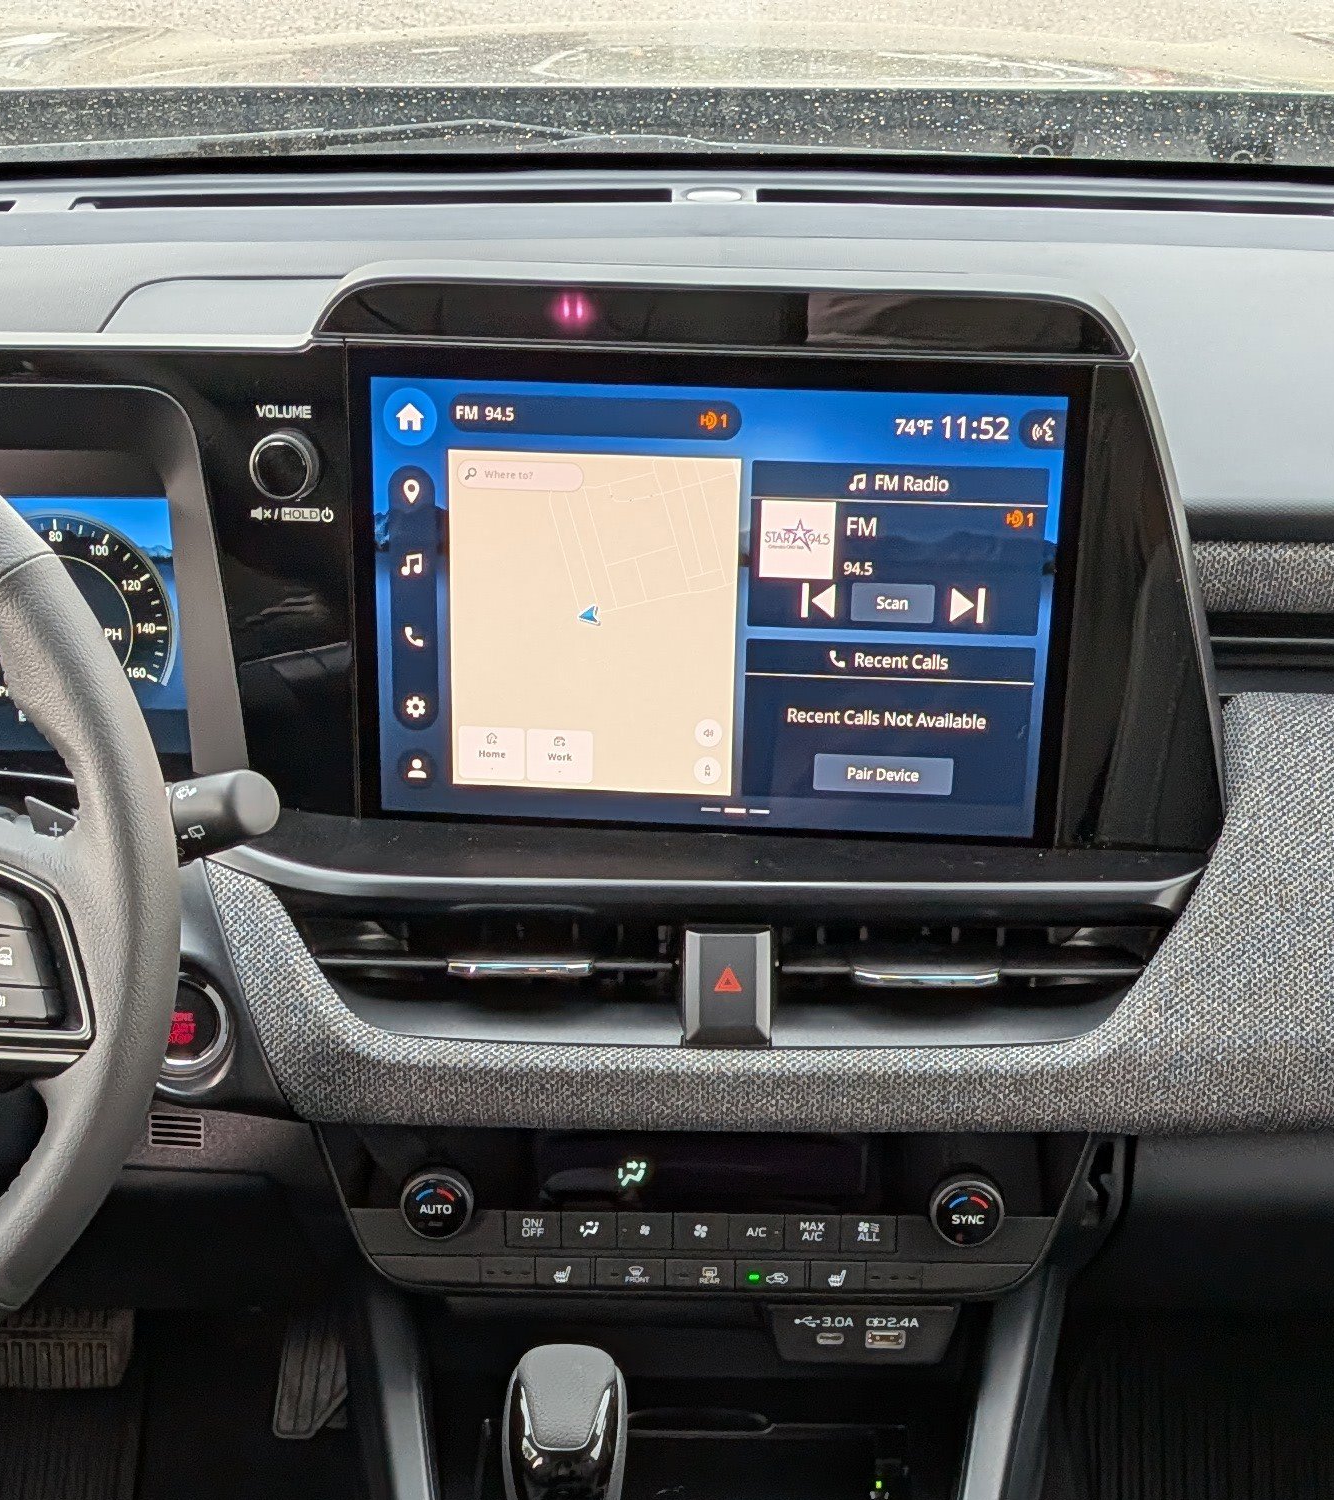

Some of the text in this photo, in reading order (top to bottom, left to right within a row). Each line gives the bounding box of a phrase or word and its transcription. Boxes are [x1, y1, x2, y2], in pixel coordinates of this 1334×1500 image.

[255, 404, 312, 419] VOLUME
[455, 406, 515, 421] FM 94.5
[895, 415, 1010, 441] 74°F 11:52
[484, 469, 534, 481] Where to?
[874, 474, 950, 492] FM Radio
[283, 509, 319, 520] HOLD
[846, 516, 878, 537] FM
[48, 531, 62, 543] 80
[764, 531, 791, 544] STAR
[89, 545, 109, 556] 100
[843, 561, 873, 576] 94.5
[121, 580, 141, 592] 120
[876, 596, 909, 611] Scan
[136, 623, 156, 634] 140
[854, 653, 950, 671] Recent Calls
[126, 667, 146, 679] 160
[787, 708, 987, 730] Recent Calls Not Available
[478, 750, 506, 759] Home
[547, 753, 573, 762] Work
[847, 767, 919, 783] Pair Device
[419, 1204, 452, 1215] AUTO
[522, 1218, 544, 1228] ON/
[951, 1214, 985, 1225] SYNC
[746, 1226, 767, 1238] A/C
[800, 1221, 826, 1231] MAX
[521, 1227, 544, 1238] OFF
[801, 1231, 824, 1242] A/C
[857, 1232, 881, 1242] ALL
[624, 1275, 651, 1284] FRONT
[698, 1276, 721, 1285] REAR
[821, 1316, 854, 1328] 3.0A
[887, 1317, 919, 1328] 2.4A
